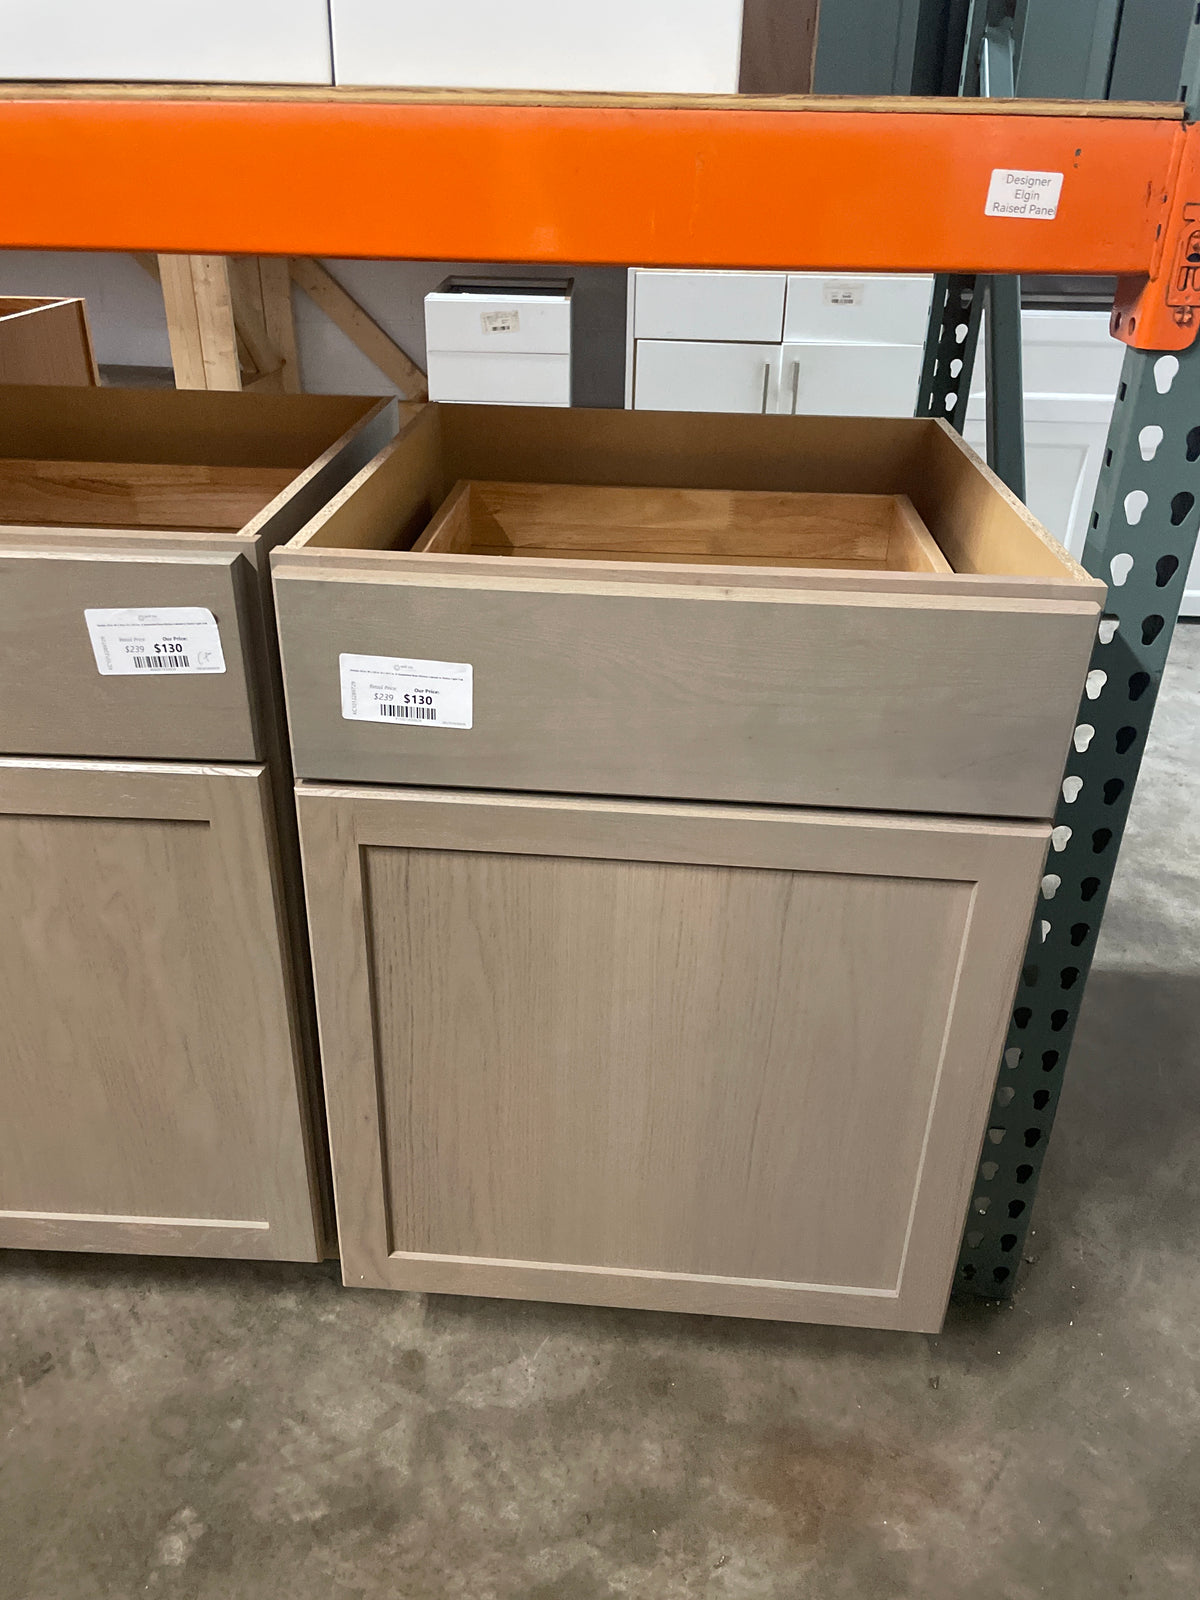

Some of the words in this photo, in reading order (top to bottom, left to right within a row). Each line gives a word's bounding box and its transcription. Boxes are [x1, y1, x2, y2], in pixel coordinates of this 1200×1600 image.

[1006, 174, 1052, 188] Designer
[1014, 189, 1040, 202] Elgin
[992, 202, 1027, 214] Raised
[125, 645, 145, 653] $239
[154, 643, 183, 653] $130
[373, 692, 394, 701] $239
[403, 693, 433, 706] $130
